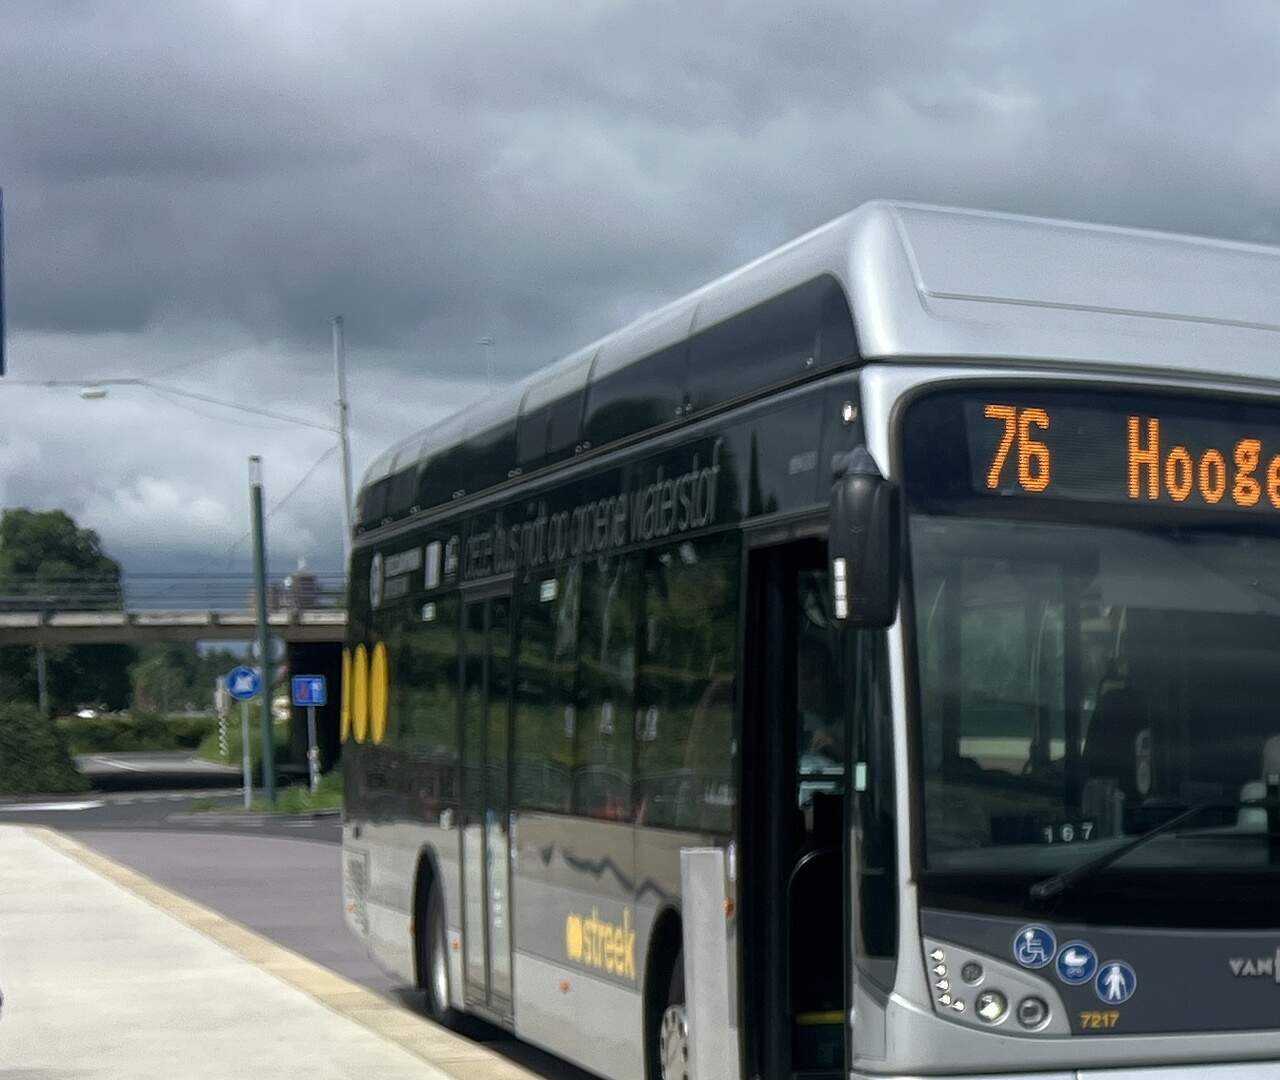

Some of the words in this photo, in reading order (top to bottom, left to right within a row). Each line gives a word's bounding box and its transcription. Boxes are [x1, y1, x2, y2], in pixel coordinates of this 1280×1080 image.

[984, 404, 1051, 493] 76
[582, 903, 636, 980] streek
[1080, 1012, 1120, 1029] 7217
